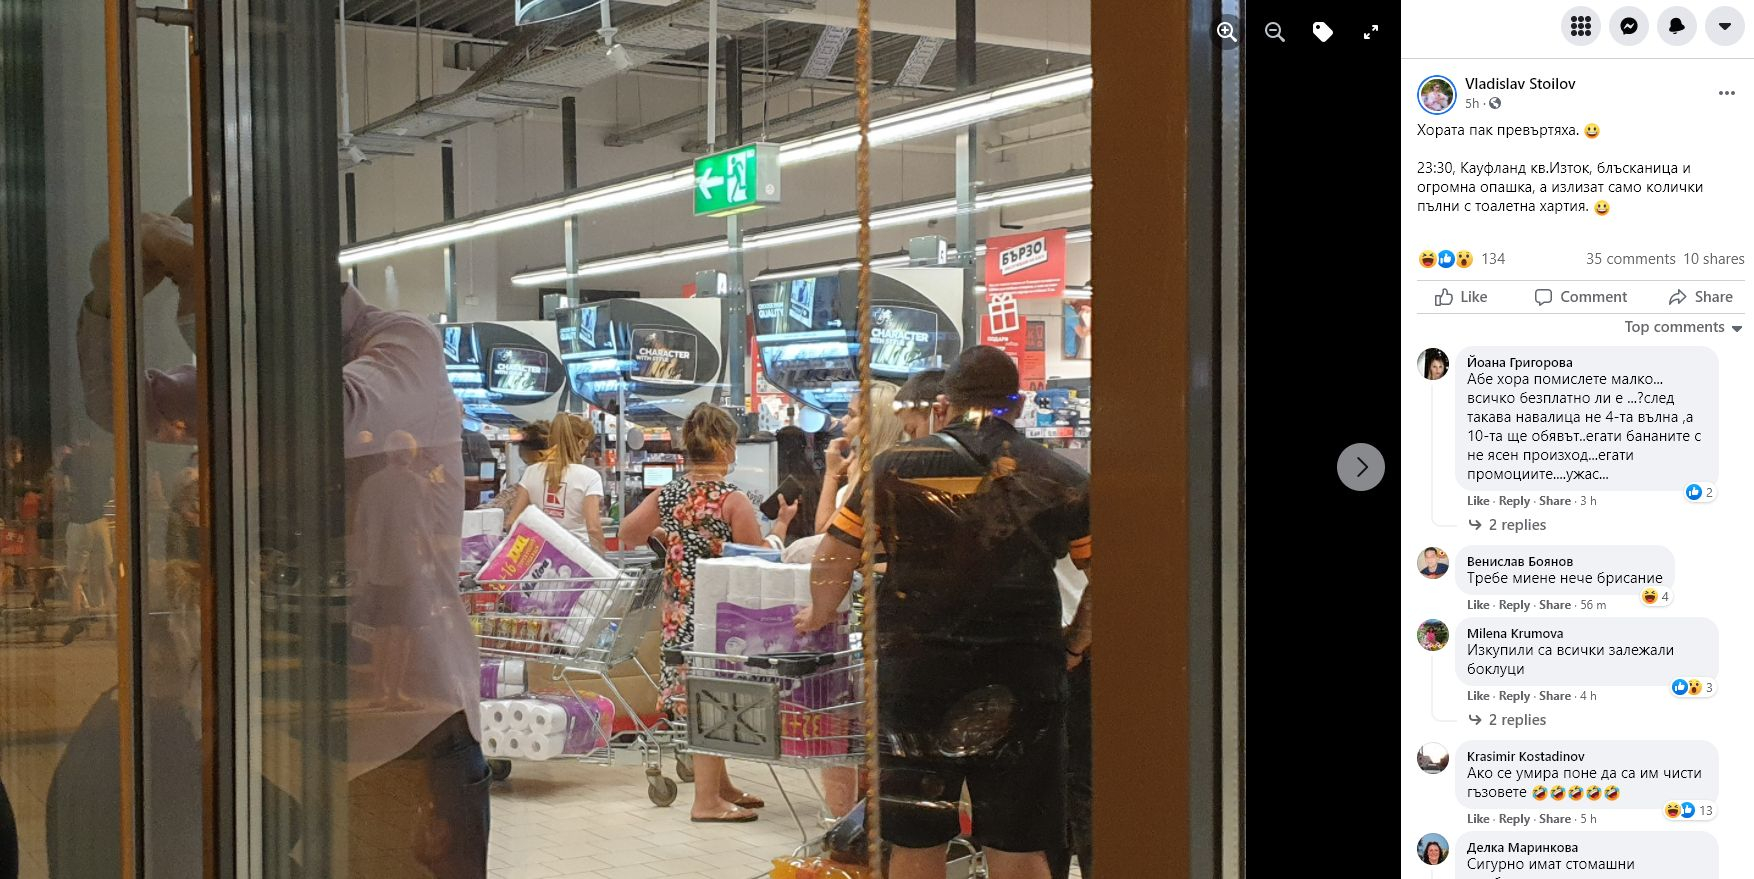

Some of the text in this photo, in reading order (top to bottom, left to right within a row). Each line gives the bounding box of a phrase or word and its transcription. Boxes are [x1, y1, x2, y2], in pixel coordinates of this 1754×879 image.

[1002, 241, 1043, 265] БЪРЗО
[758, 308, 784, 319] QUALITY
[871, 328, 930, 343] CHARACTER
[638, 347, 690, 360] CHARACTER
[497, 363, 541, 374] CHARACTER
